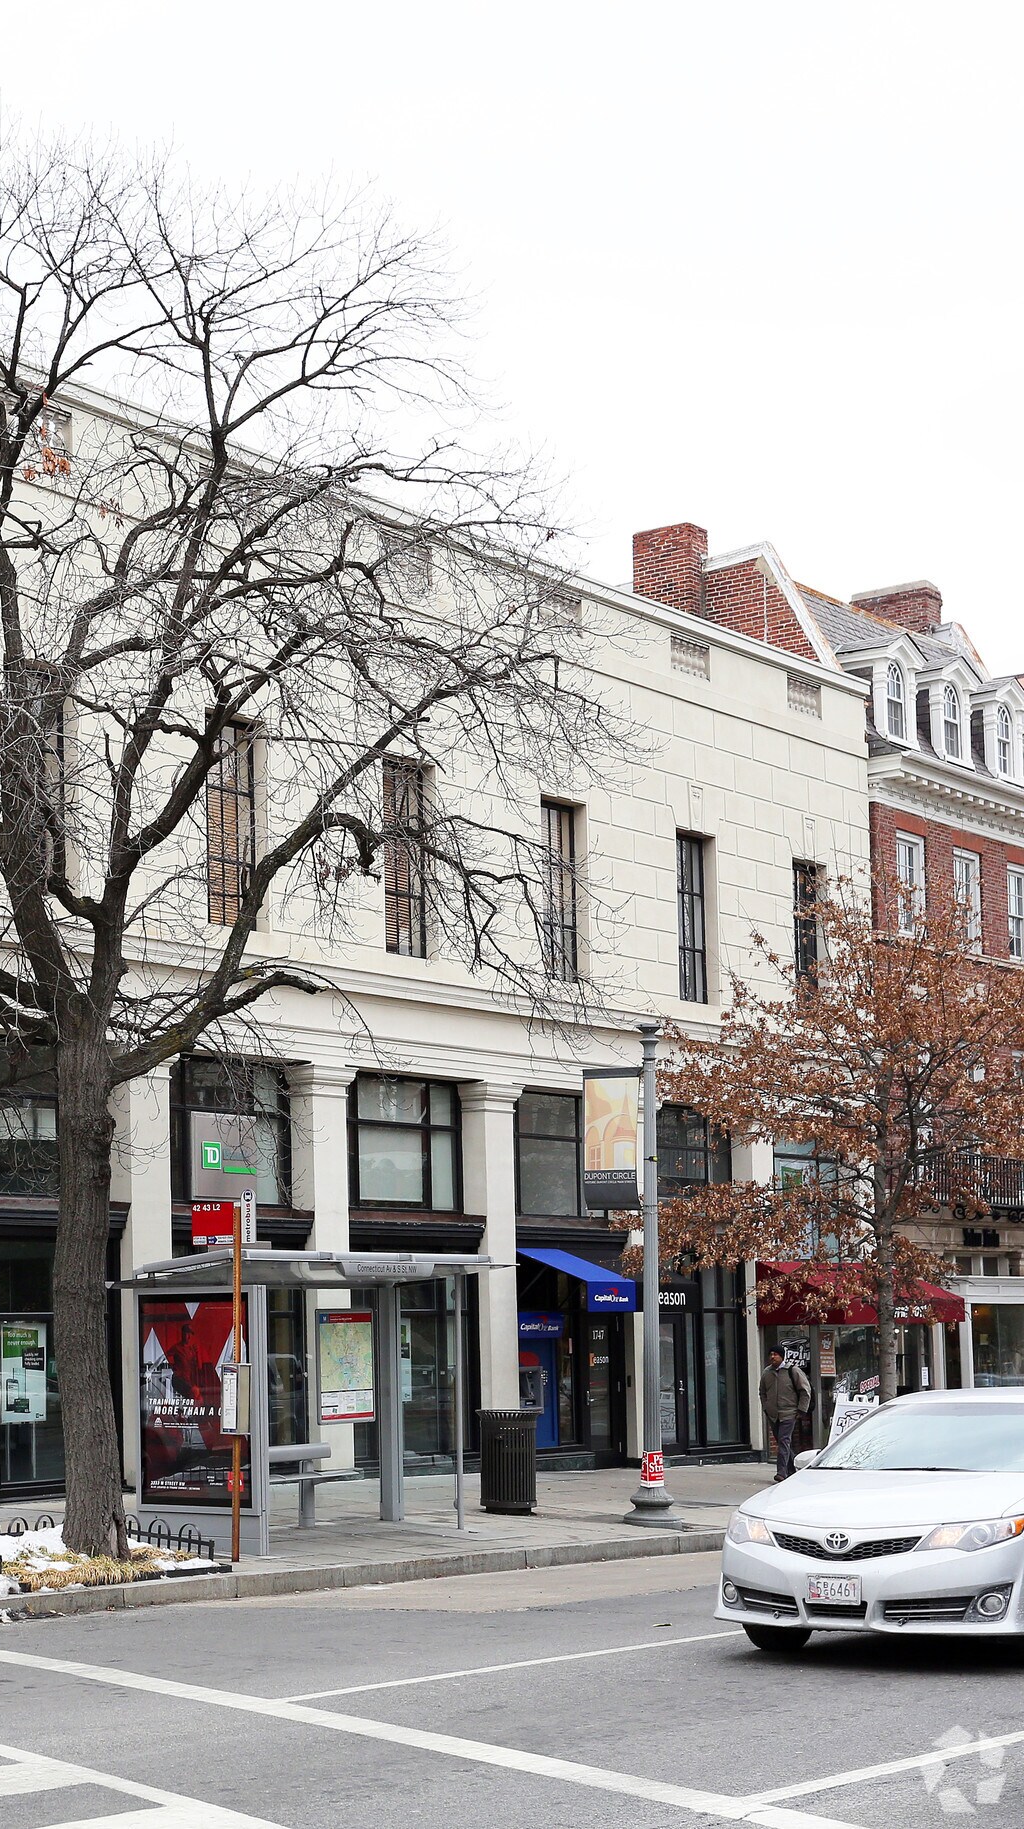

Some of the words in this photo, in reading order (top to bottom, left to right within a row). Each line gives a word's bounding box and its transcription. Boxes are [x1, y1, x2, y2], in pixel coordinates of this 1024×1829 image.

[204, 1146, 220, 1164] TD
[584, 1172, 611, 1180] DUPONT
[612, 1171, 636, 1180] CIRCLE
[192, 1204, 201, 1212] 42
[202, 1204, 211, 1212] 43
[212, 1203, 221, 1211] L2
[357, 1263, 385, 1273] Connecticut
[386, 1265, 392, 1273] Av
[409, 1265, 417, 1274] NW
[658, 1291, 686, 1306] eason
[592, 1330, 605, 1340] 1747
[149, 1398, 180, 1406] TRAINING
[182, 1398, 194, 1406] FOR
[154, 1405, 179, 1415] MORE
[183, 1406, 206, 1416] THAN
[209, 1407, 215, 1416] A
